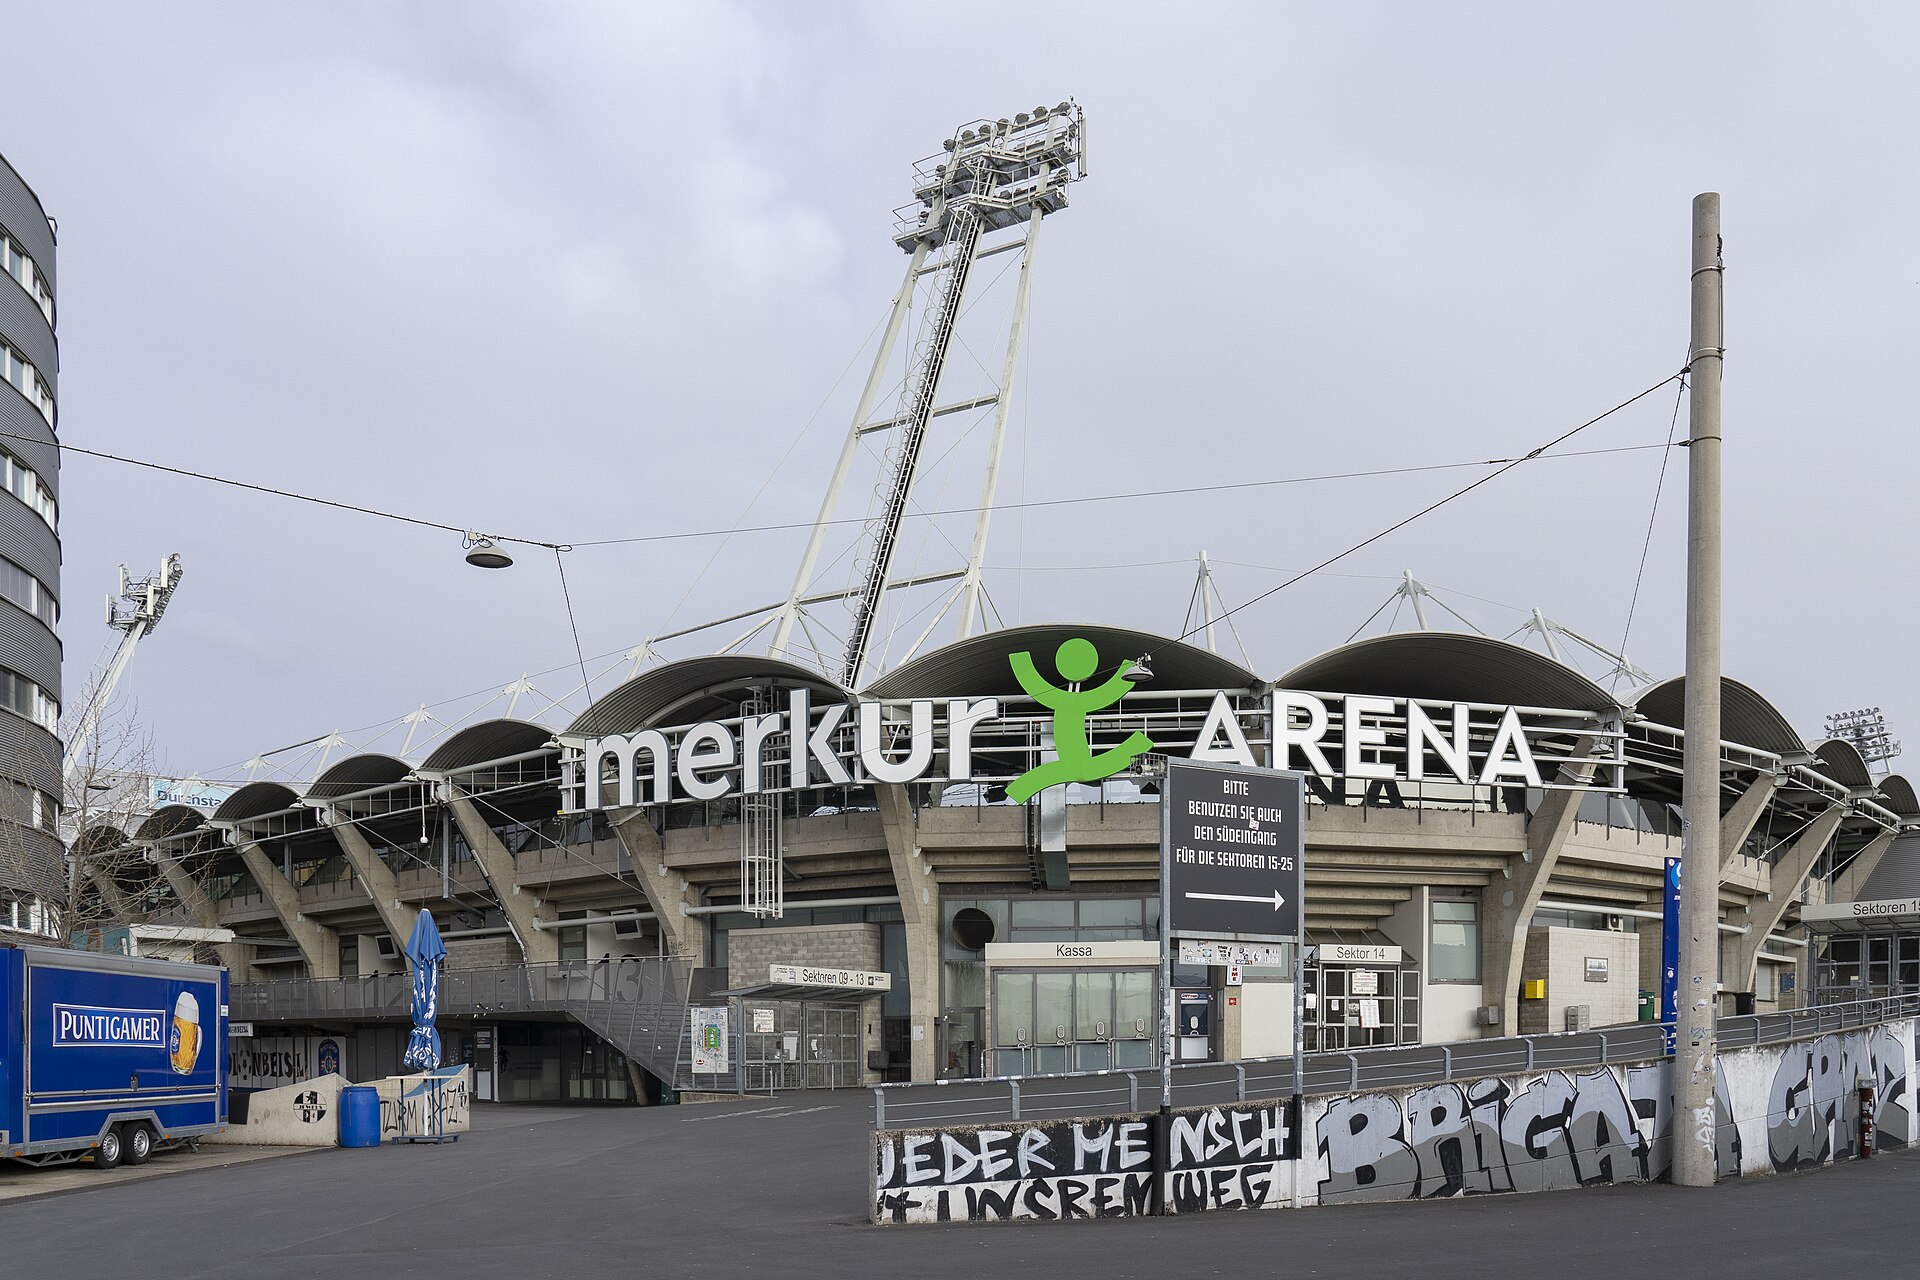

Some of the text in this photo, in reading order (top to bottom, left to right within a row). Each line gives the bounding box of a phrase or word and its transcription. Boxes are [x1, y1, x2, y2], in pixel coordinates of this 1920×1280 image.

[584, 688, 1543, 810] merkur ARENA
[1223, 779, 1249, 795] BITTE
[1188, 800, 1282, 823] BENUTZEN SIE AUCH
[1194, 825, 1277, 846] DEN SÜDEINGANG
[1176, 846, 1293, 871] FÜR DIE SEKTOREN 15-25
[1853, 900, 1920, 916] Sektoren 1
[1056, 944, 1092, 957] Kassa
[1336, 946, 1385, 960] Sektor 14
[589, 953, 645, 1001] 13
[802, 968, 837, 984] Sektoren
[838, 971, 849, 985] 09
[855, 973, 865, 986] 13
[60, 1010, 160, 1041] PUNTIGAMER
[877, 1128, 1056, 1188] JEDER
[1173, 1163, 1274, 1214] WEG
